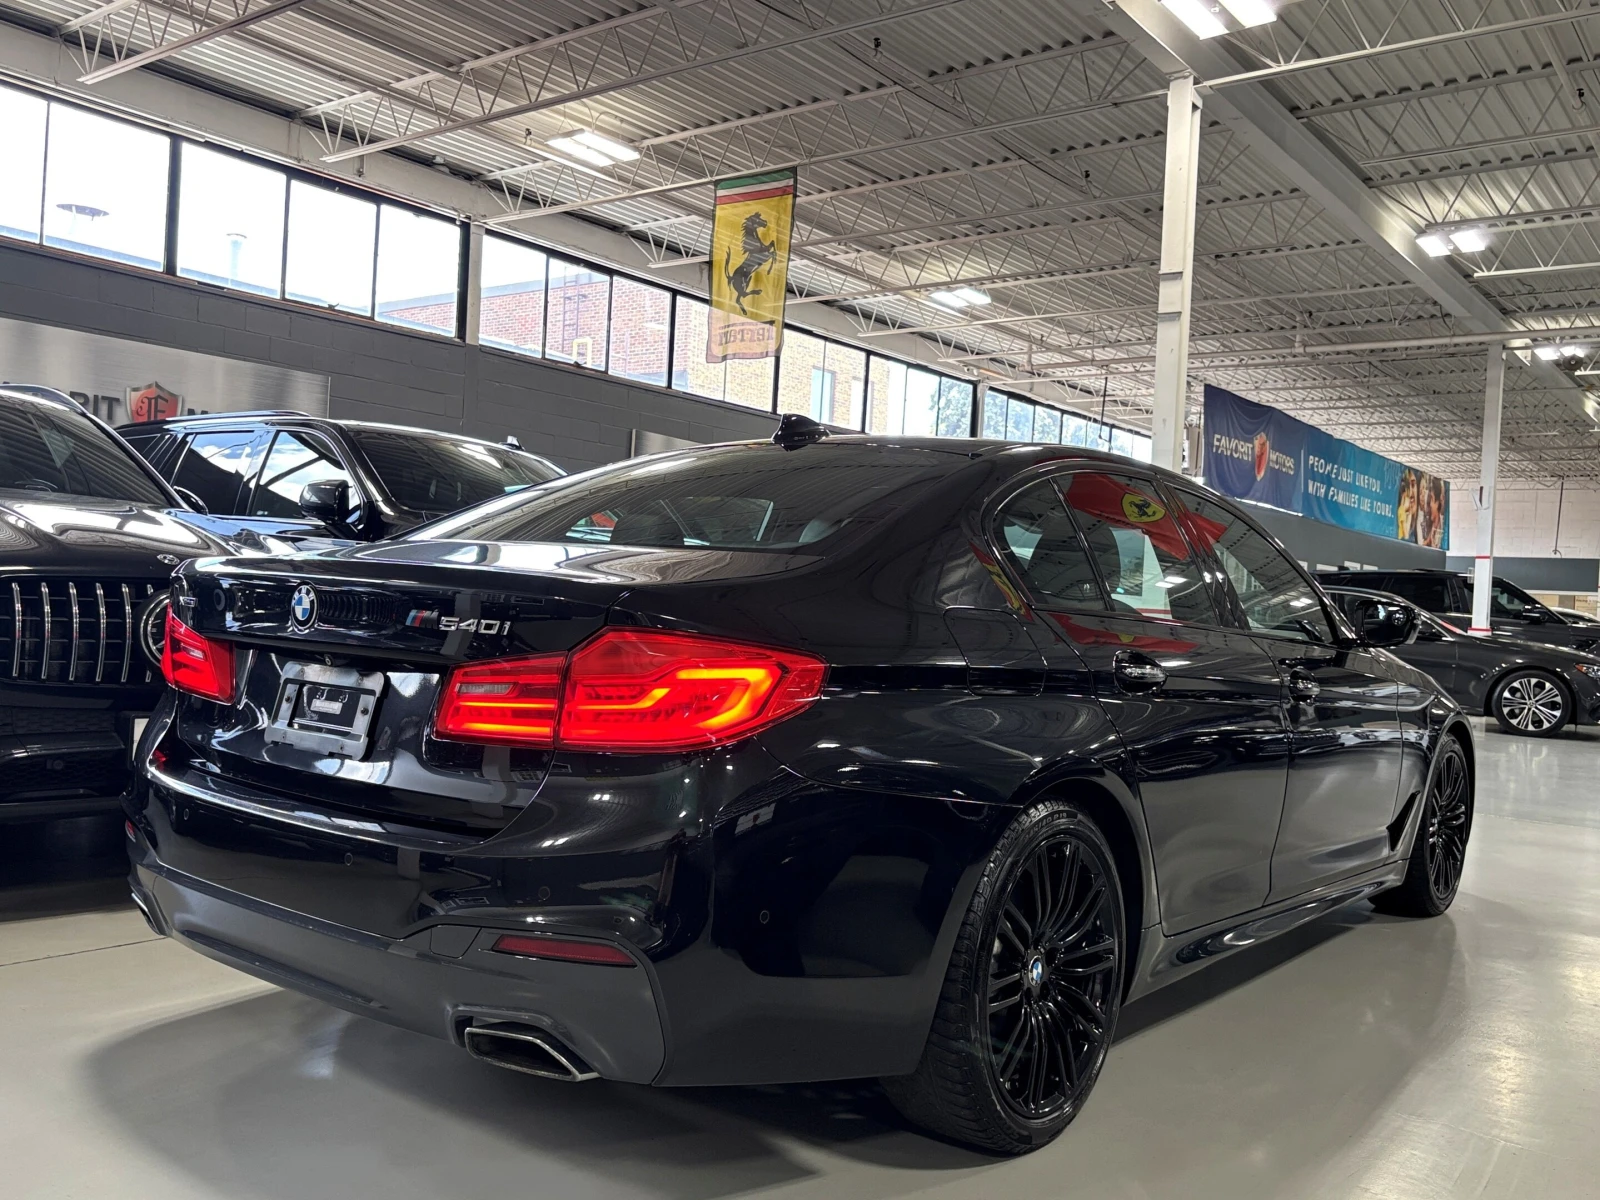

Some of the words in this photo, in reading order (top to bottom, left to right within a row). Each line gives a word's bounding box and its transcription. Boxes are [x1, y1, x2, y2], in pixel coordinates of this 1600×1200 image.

[1213, 434, 1253, 461] FAVORIT
[1270, 449, 1295, 475] MOTORS
[1338, 467, 1354, 483] JUST
[1355, 472, 1368, 489] LIKE
[1308, 479, 1326, 498] WITH
[1360, 496, 1371, 512] LIKE
